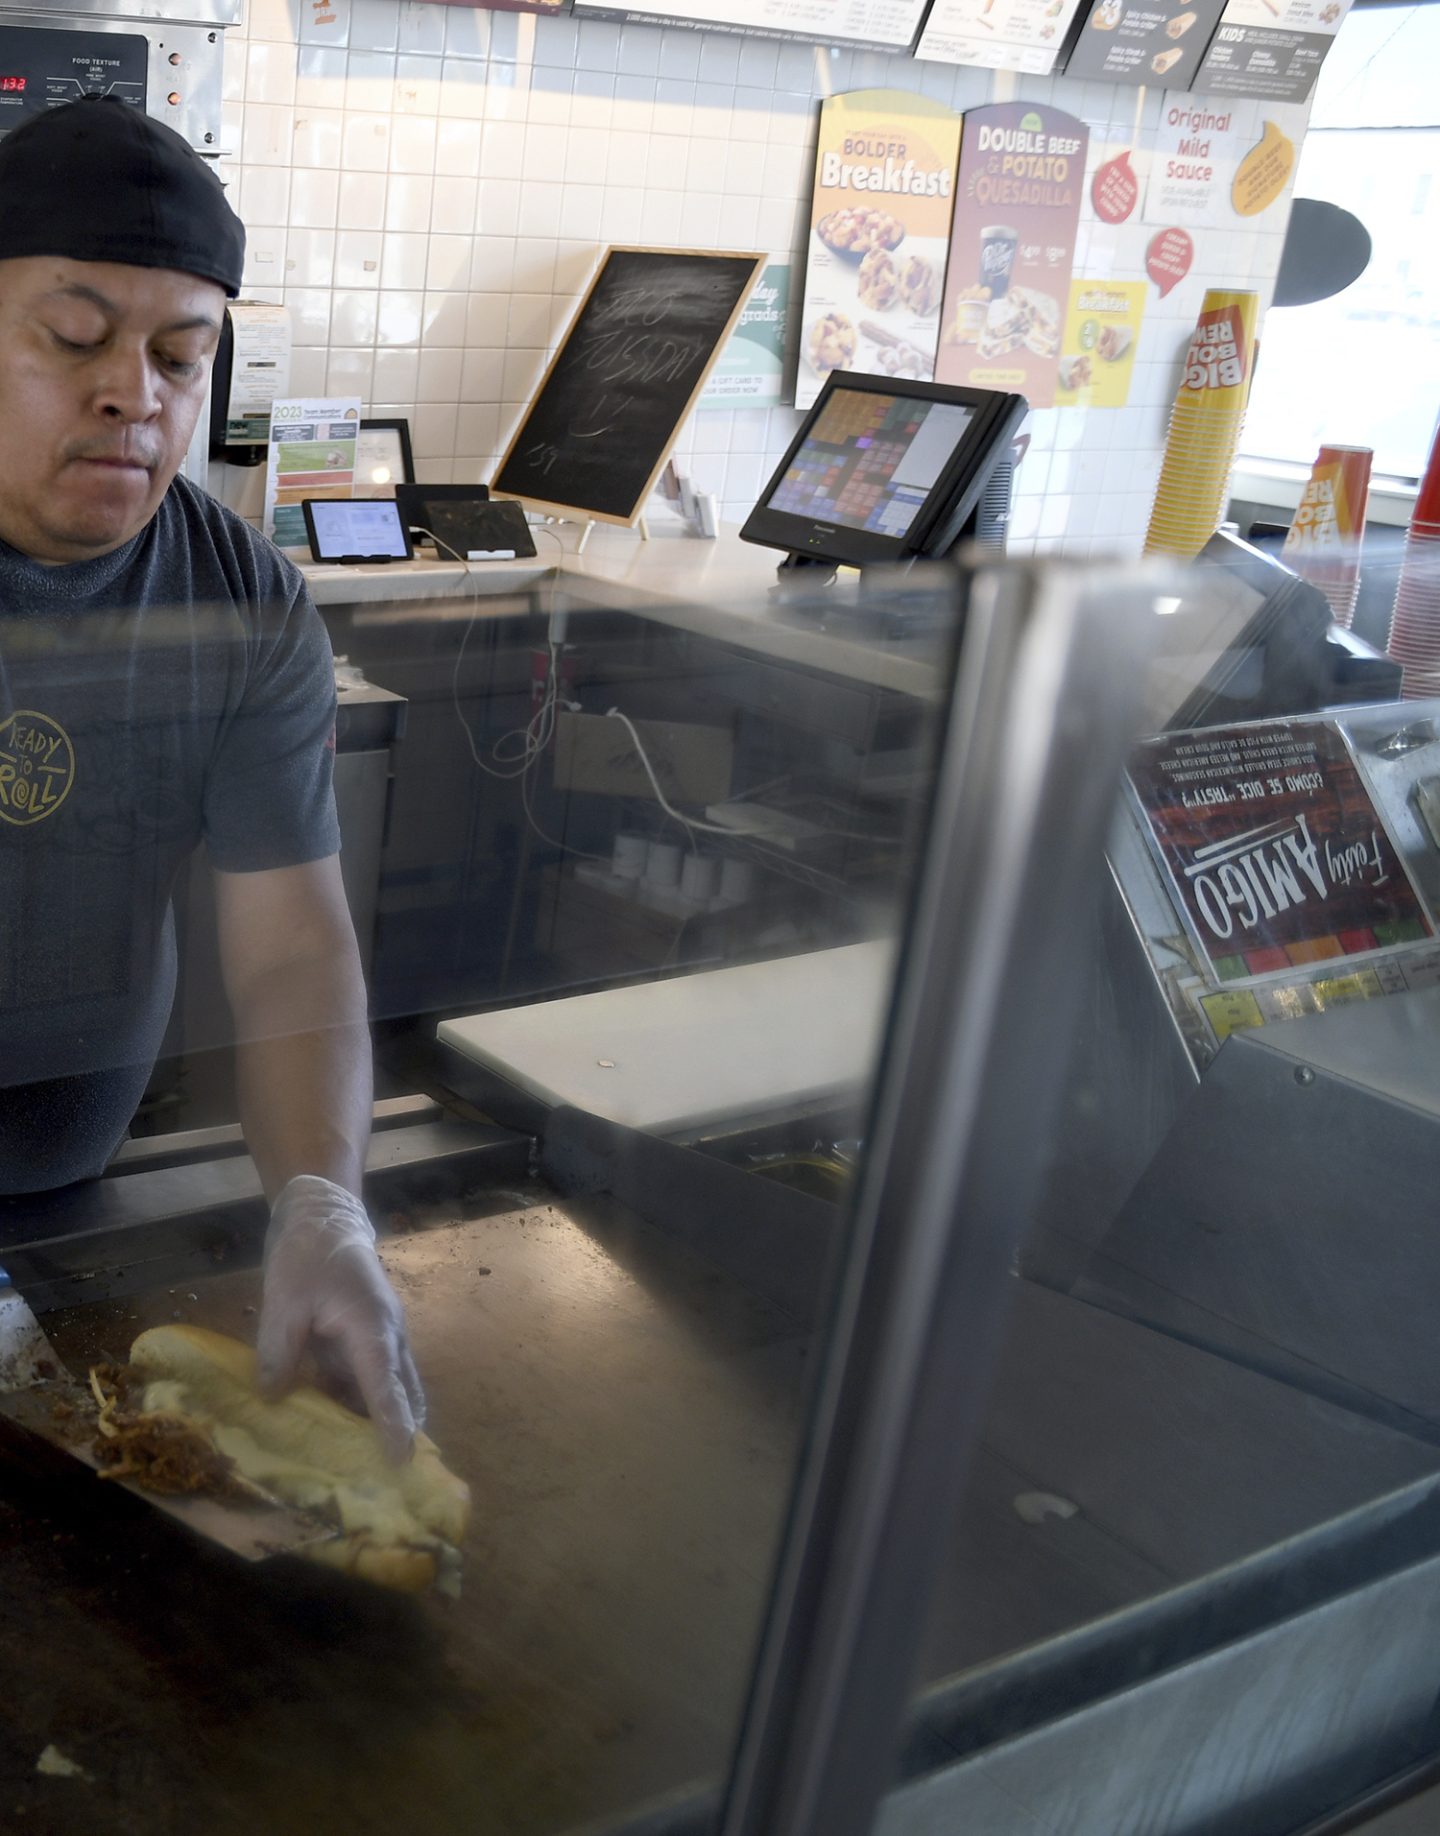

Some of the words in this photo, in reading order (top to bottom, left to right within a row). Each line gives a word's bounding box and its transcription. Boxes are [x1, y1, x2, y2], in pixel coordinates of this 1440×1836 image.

[1217, 26, 1246, 43] KIDS
[71, 57, 90, 65] FOOD
[92, 58, 121, 67] TEXTURE
[2, 77, 27, 91] 132
[1167, 105, 1232, 134] Original
[844, 138, 907, 160] BOLDER
[978, 125, 1046, 153] DOUBLE
[1047, 136, 1082, 155] BEEF
[1177, 137, 1212, 158] Mild
[820, 151, 952, 198] Breakfast
[1002, 155, 1068, 183] POTATO
[1166, 160, 1213, 181] Sauce
[975, 175, 1073, 208] QUESADILLA
[592, 287, 673, 327] TACO
[1191, 320, 1234, 346] REW
[1186, 341, 1238, 364] BOL
[273, 406, 302, 419] 2023
[1303, 478, 1334, 504] RE
[1292, 502, 1337, 528] BO
[8, 721, 62, 764] READY
[18, 753, 33, 776] TO
[1236, 780, 1266, 799] DICE
[1266, 776, 1284, 794] SE
[1285, 771, 1325, 797] ¿CÓMO
[1324, 830, 1390, 887] Feisty
[1193, 813, 1328, 939] AMIGO
